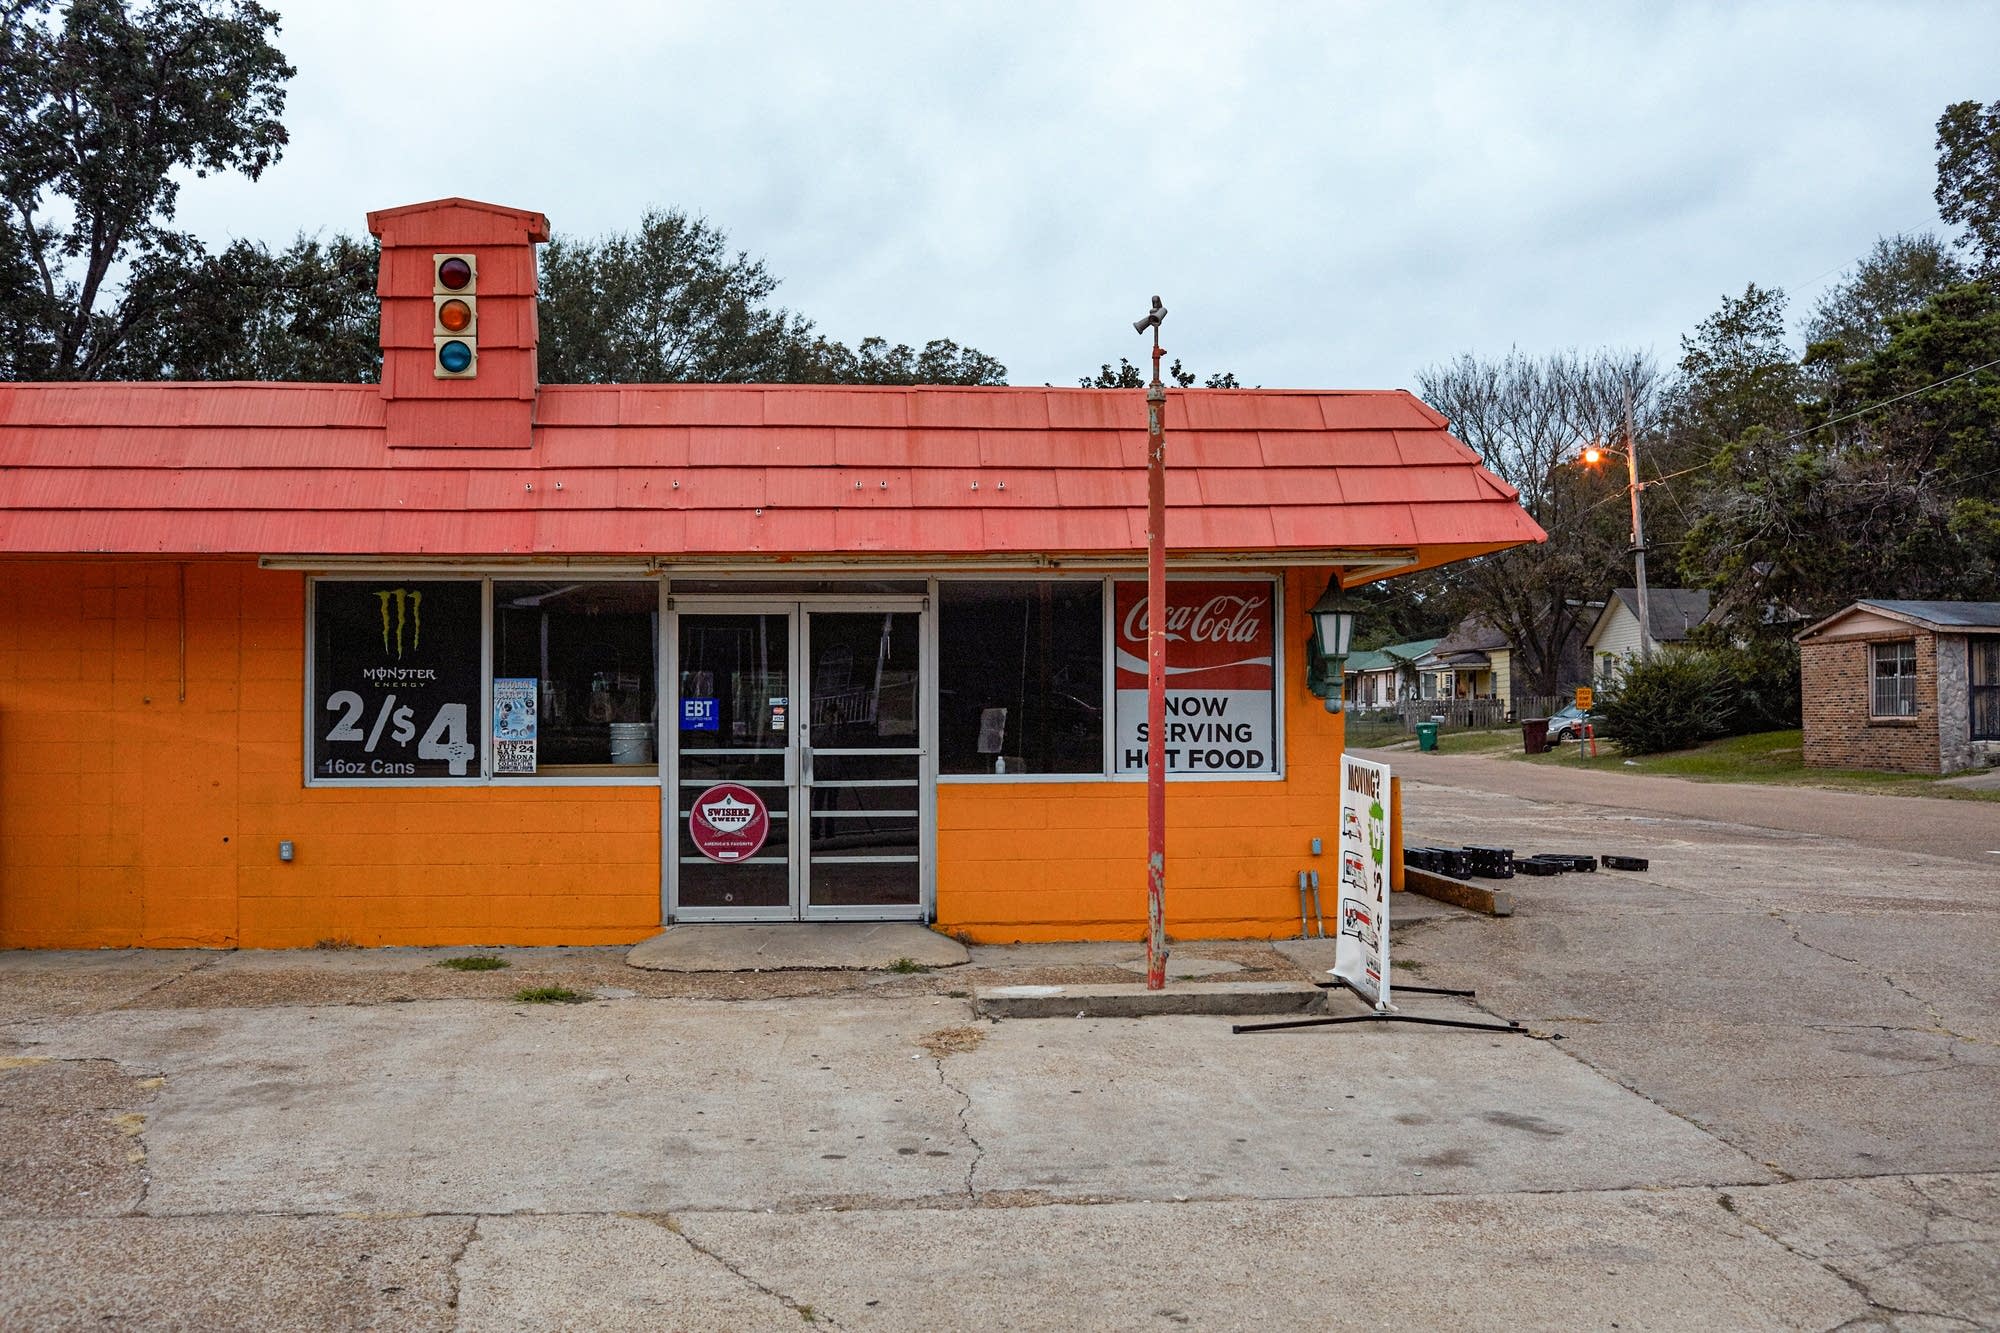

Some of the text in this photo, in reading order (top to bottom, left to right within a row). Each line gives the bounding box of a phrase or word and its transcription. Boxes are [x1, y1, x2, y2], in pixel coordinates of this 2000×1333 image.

[363, 667, 438, 680] MONSTER
[685, 701, 713, 717] EBT
[1163, 697, 1229, 717] NOW
[519, 745, 534, 753] 24
[325, 759, 415, 774] 16oz Cans
[1125, 749, 1264, 769] HT FOOD
[1348, 763, 1380, 800] MOVING?
[708, 808, 750, 816] SWISHER
